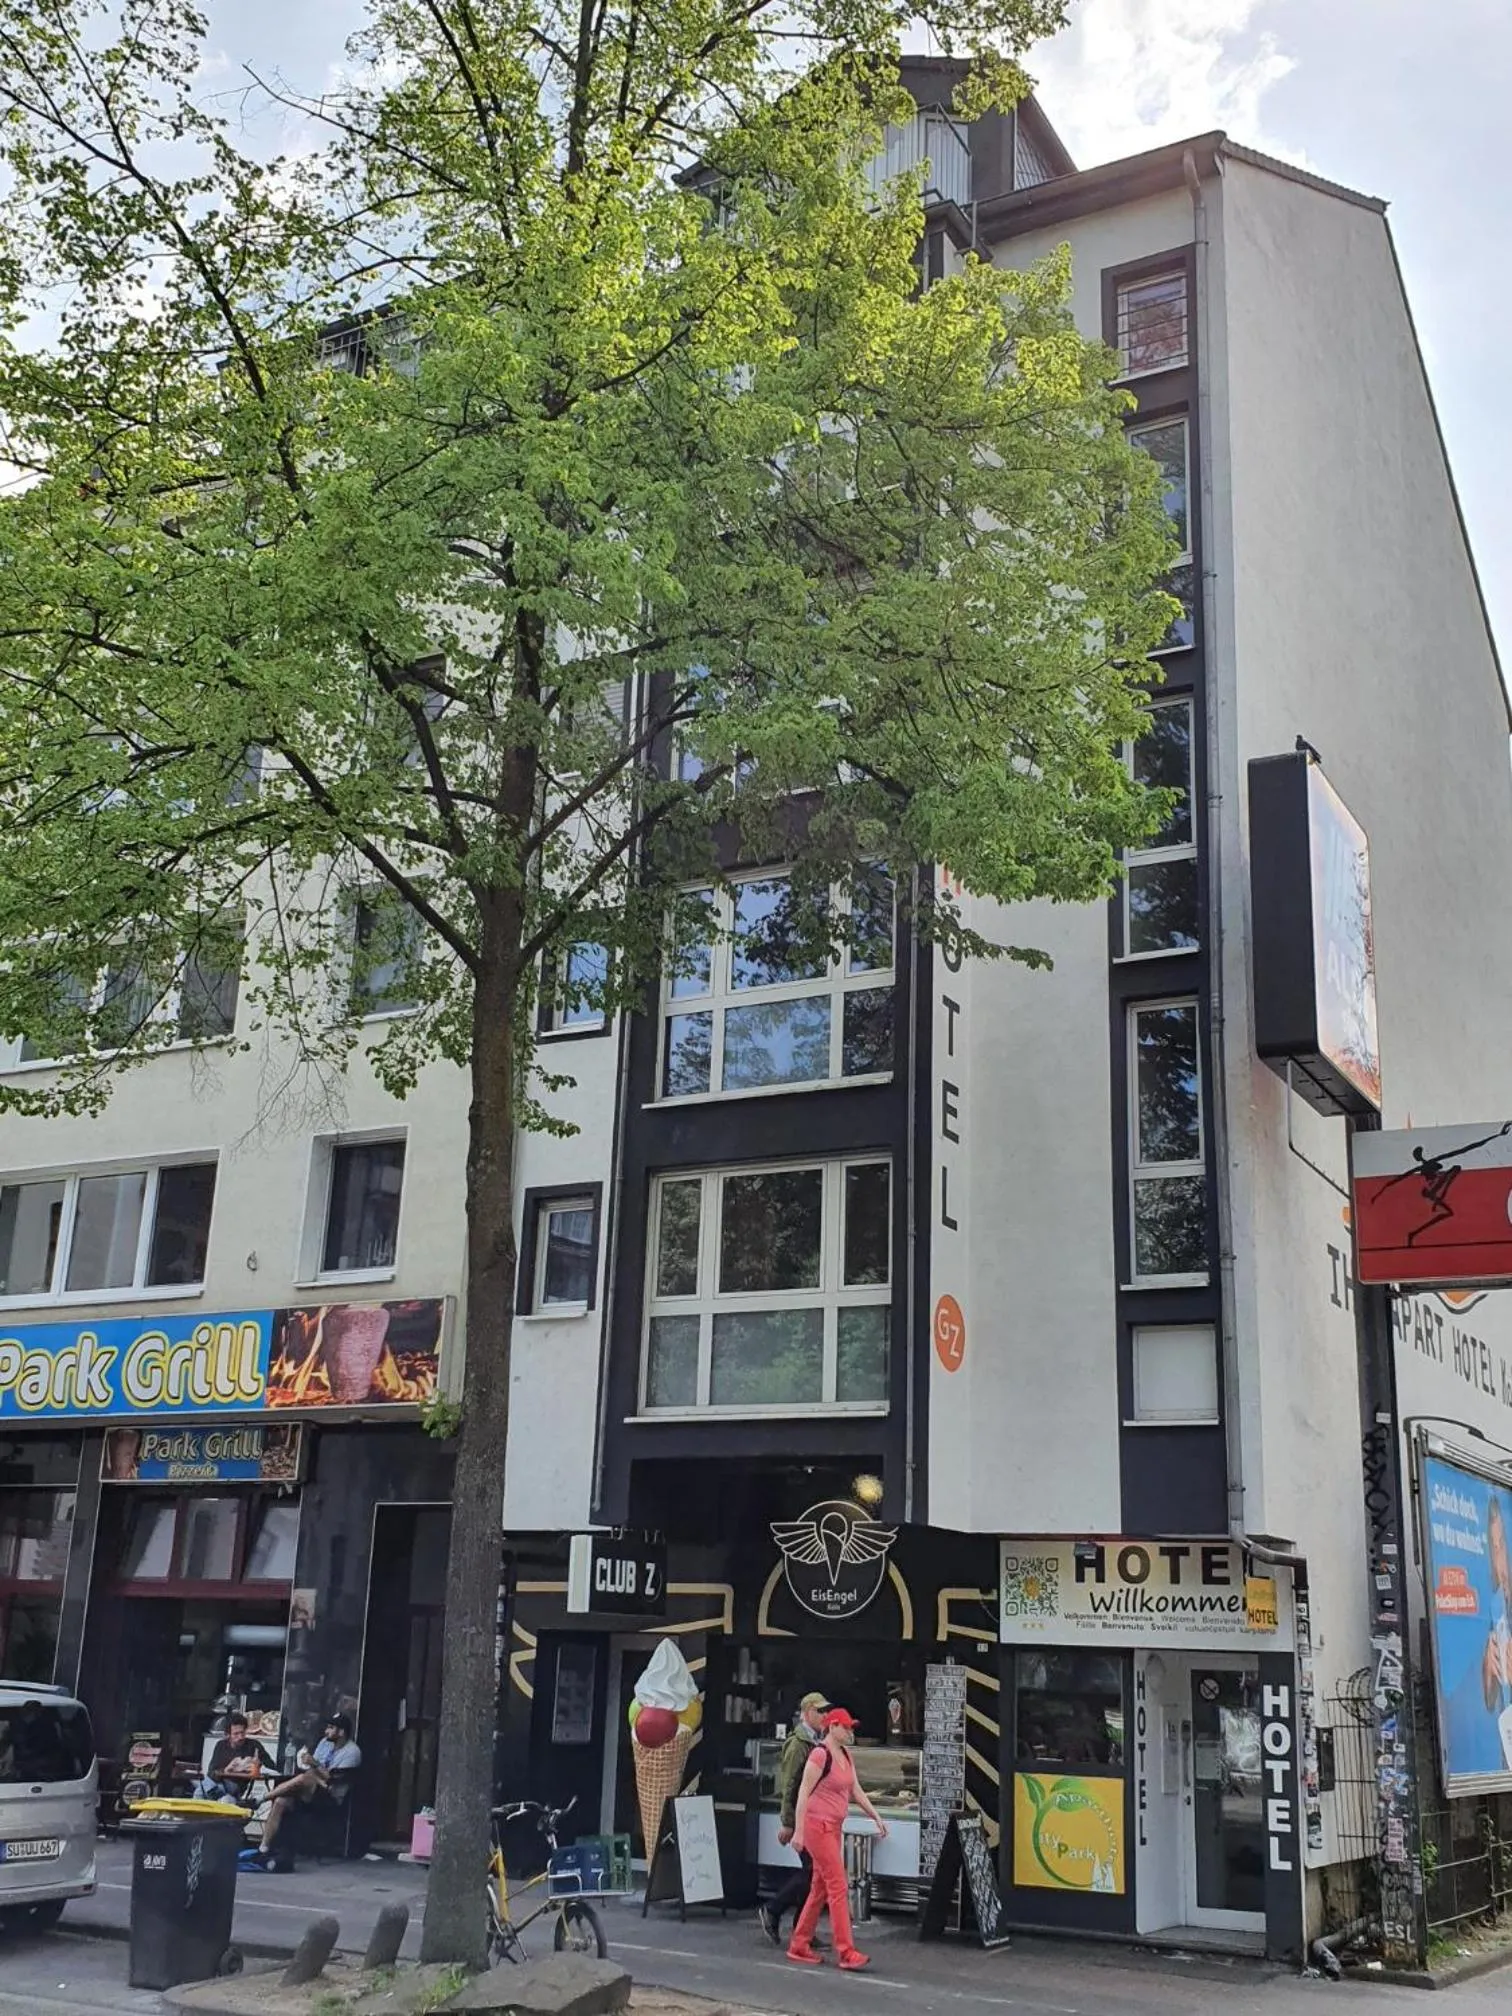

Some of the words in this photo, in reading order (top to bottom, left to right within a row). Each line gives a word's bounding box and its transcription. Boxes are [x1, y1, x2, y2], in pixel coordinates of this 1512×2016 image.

[0, 1332, 117, 1410] Park
[123, 1322, 263, 1406] Grill
[1392, 1296, 1444, 1364] APART
[1452, 1325, 1496, 1397] HOTEL
[142, 1431, 198, 1461] Park
[204, 1427, 262, 1460] Grill
[595, 1557, 637, 1594] CLUB
[644, 1562, 656, 1596] Z
[811, 1588, 857, 1605] EisEngel
[1249, 1608, 1278, 1625] HOTEL
[1136, 1669, 1148, 1847] HOTEL
[1262, 1684, 1293, 1871] HOTEL
